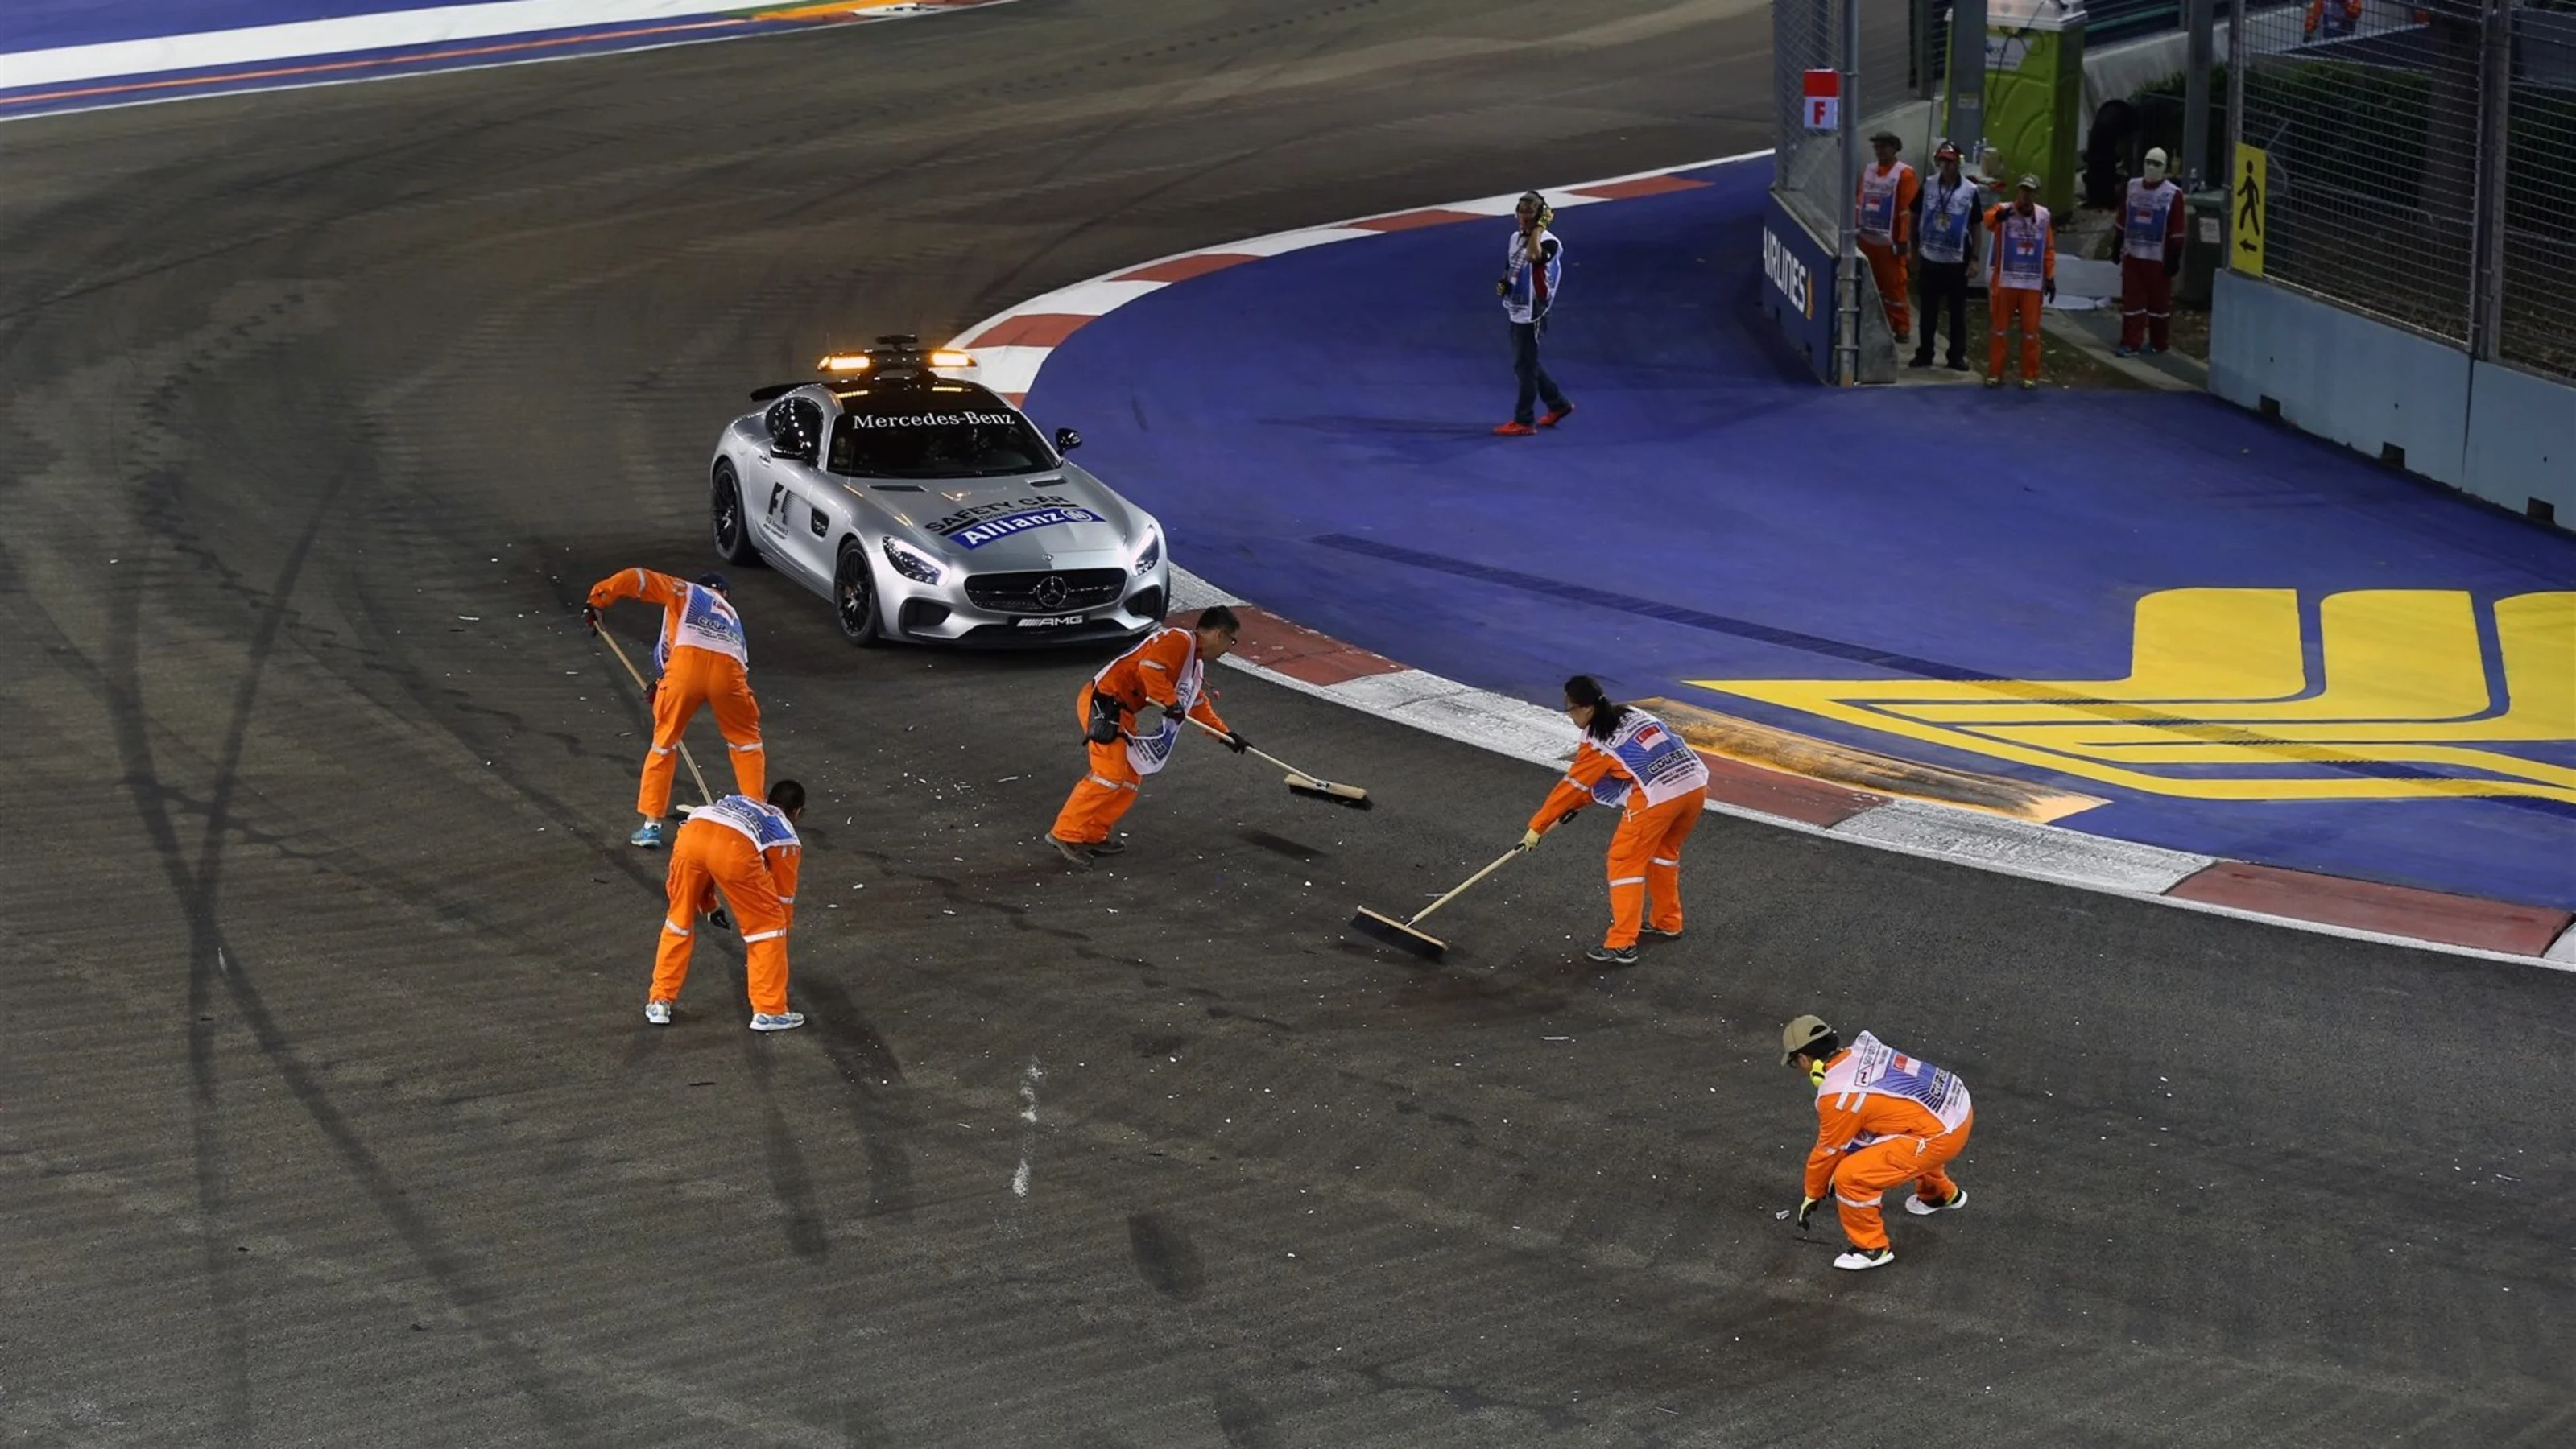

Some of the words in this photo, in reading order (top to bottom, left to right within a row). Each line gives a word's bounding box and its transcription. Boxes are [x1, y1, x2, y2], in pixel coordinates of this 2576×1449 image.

[1813, 101, 1826, 125] F
[853, 411, 1015, 429] Mercedes-Benz
[924, 501, 1014, 532] SAFETY
[1019, 495, 1071, 506] CAR
[961, 508, 1065, 546] Allianz
[1039, 615, 1082, 626] AMG
